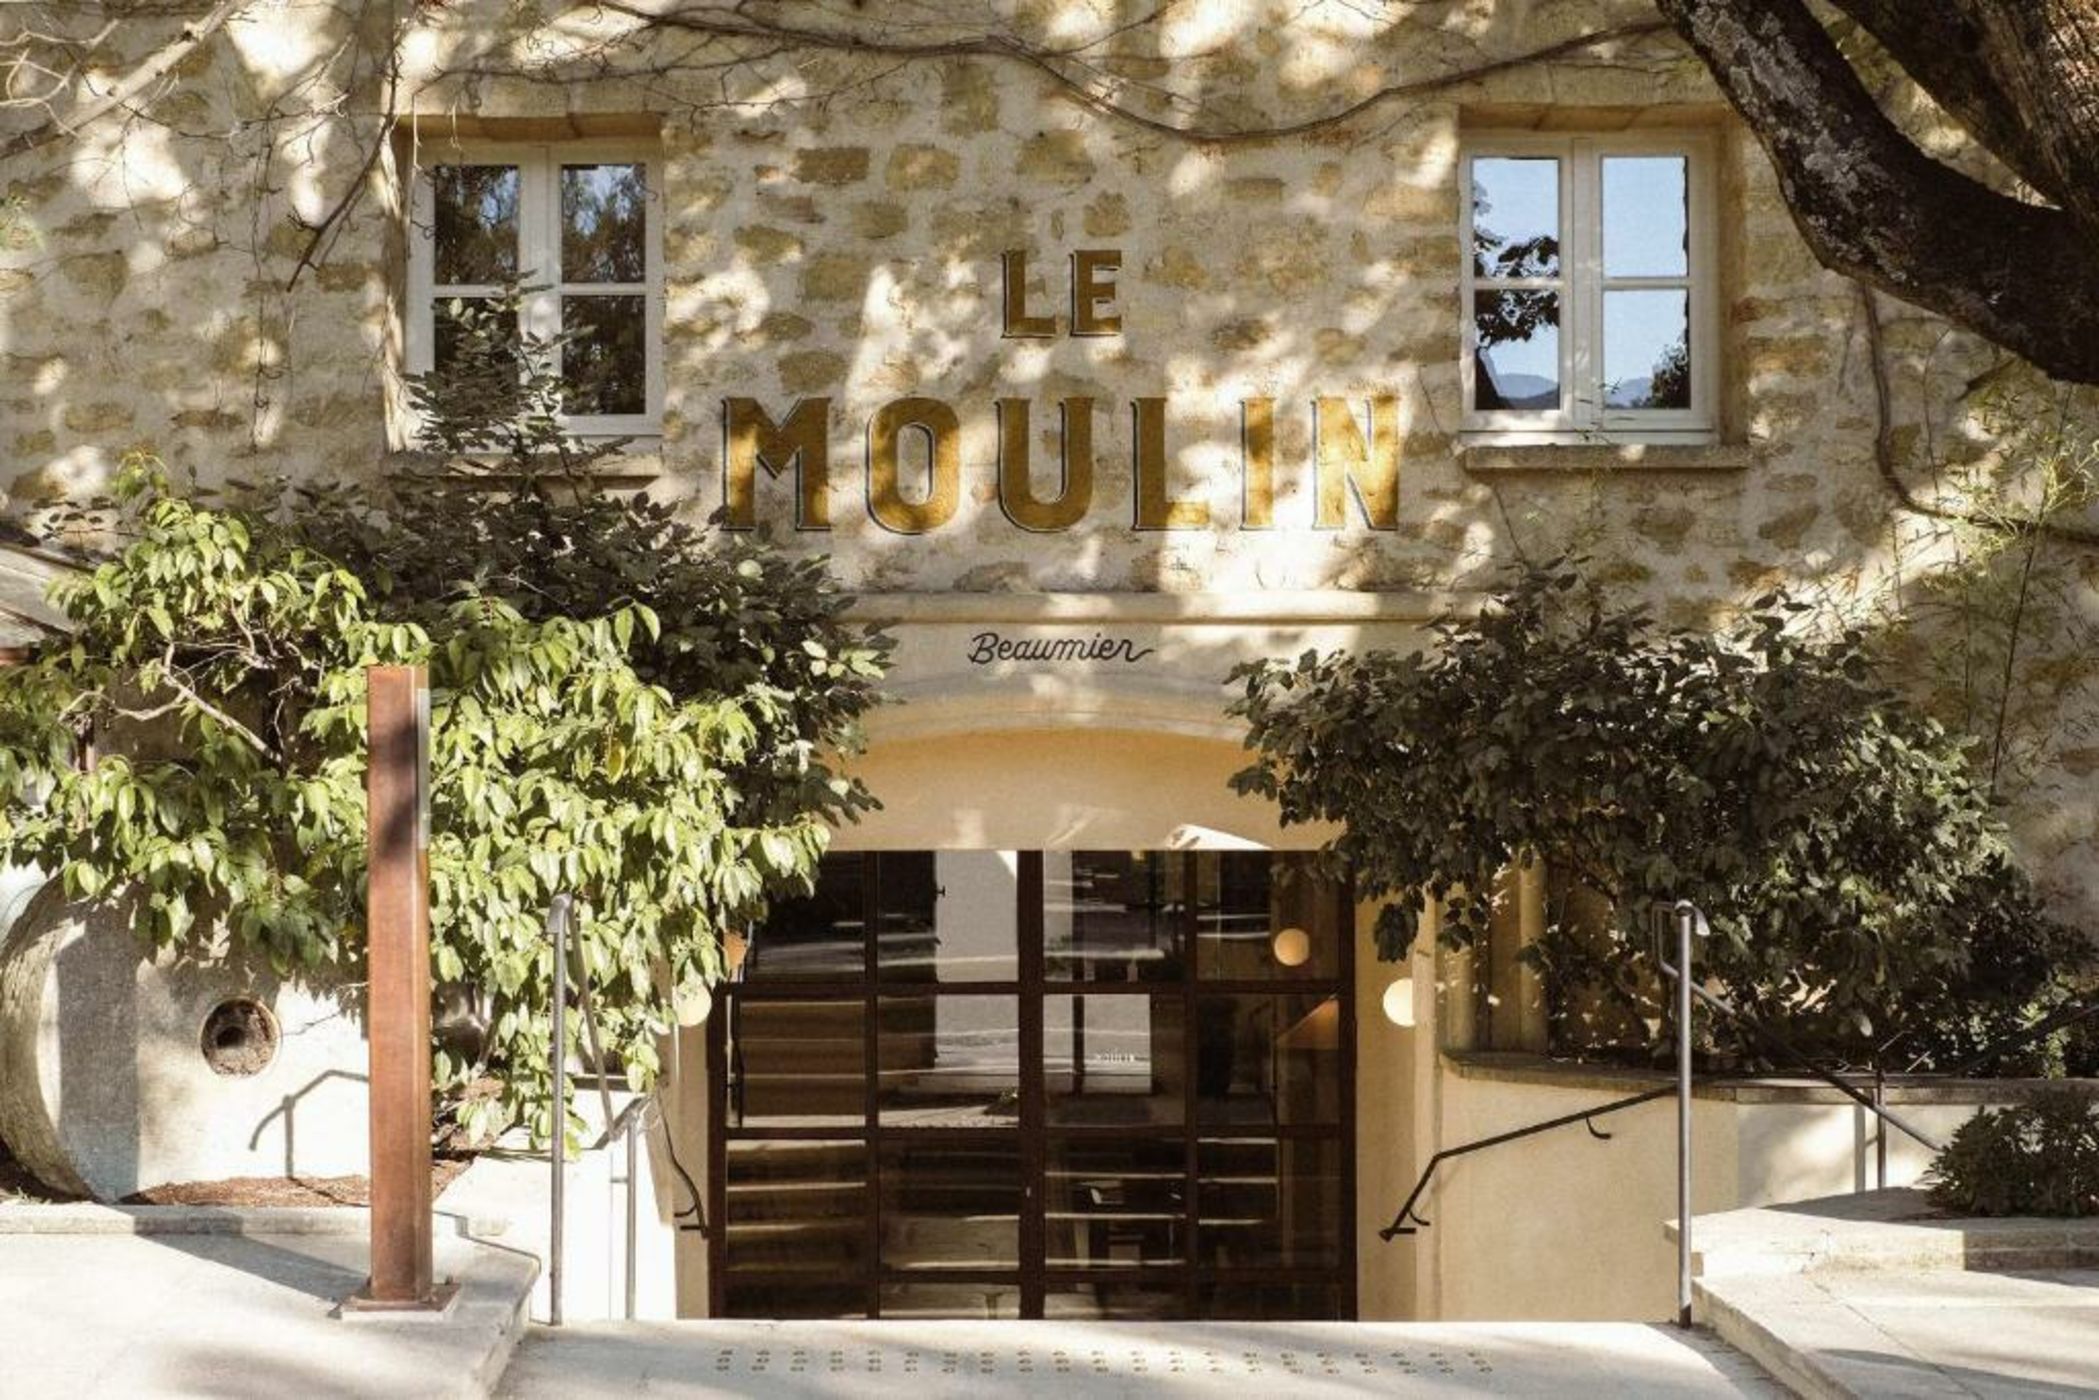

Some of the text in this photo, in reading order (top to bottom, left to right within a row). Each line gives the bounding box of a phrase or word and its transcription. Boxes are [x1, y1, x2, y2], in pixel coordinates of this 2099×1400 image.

[1001, 249, 1122, 338] LE
[720, 396, 1401, 534] MOULIN
[968, 632, 1155, 664] Beaumier
